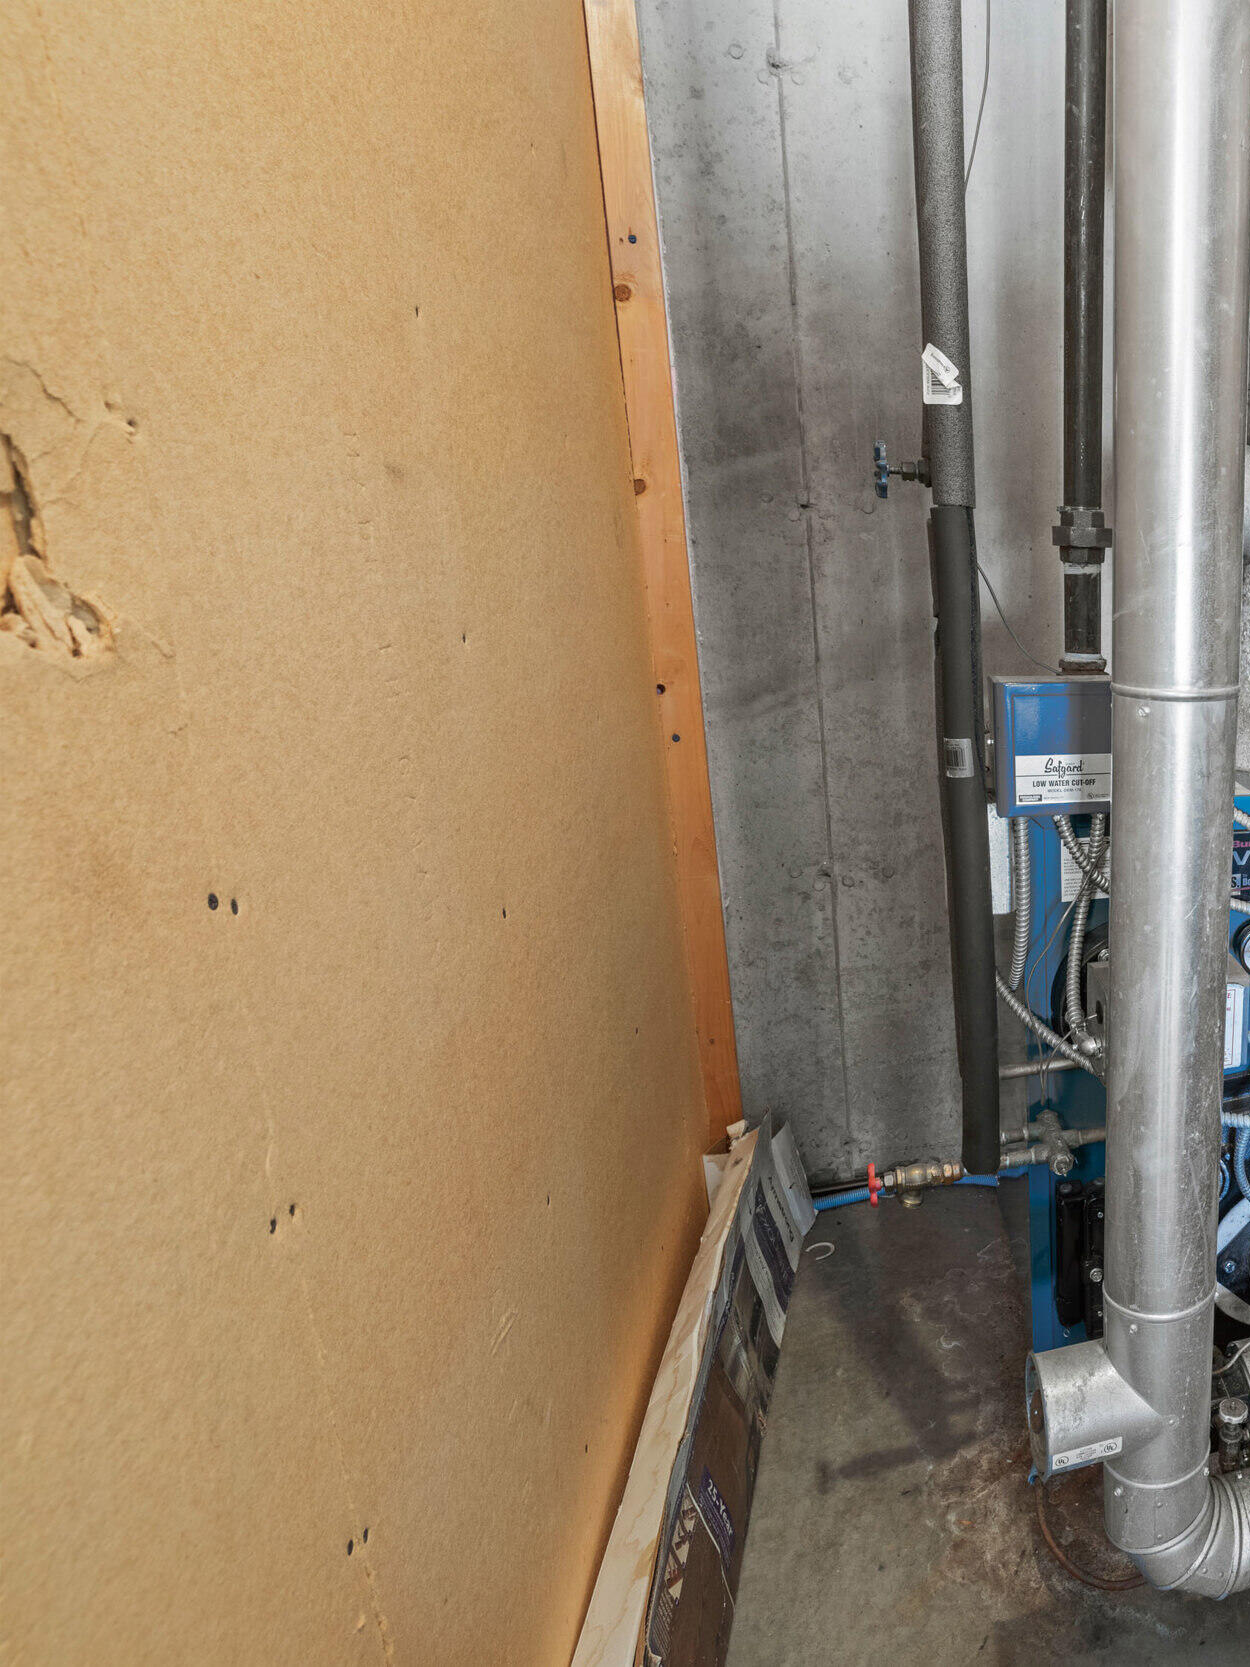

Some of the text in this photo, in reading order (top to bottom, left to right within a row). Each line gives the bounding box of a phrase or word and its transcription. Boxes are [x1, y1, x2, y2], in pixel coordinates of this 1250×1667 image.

[1044, 757, 1083, 779] Safgard
[1032, 778, 1096, 788] LOW WATER CUT-OFF
[708, 1479, 733, 1535] 25-Year
